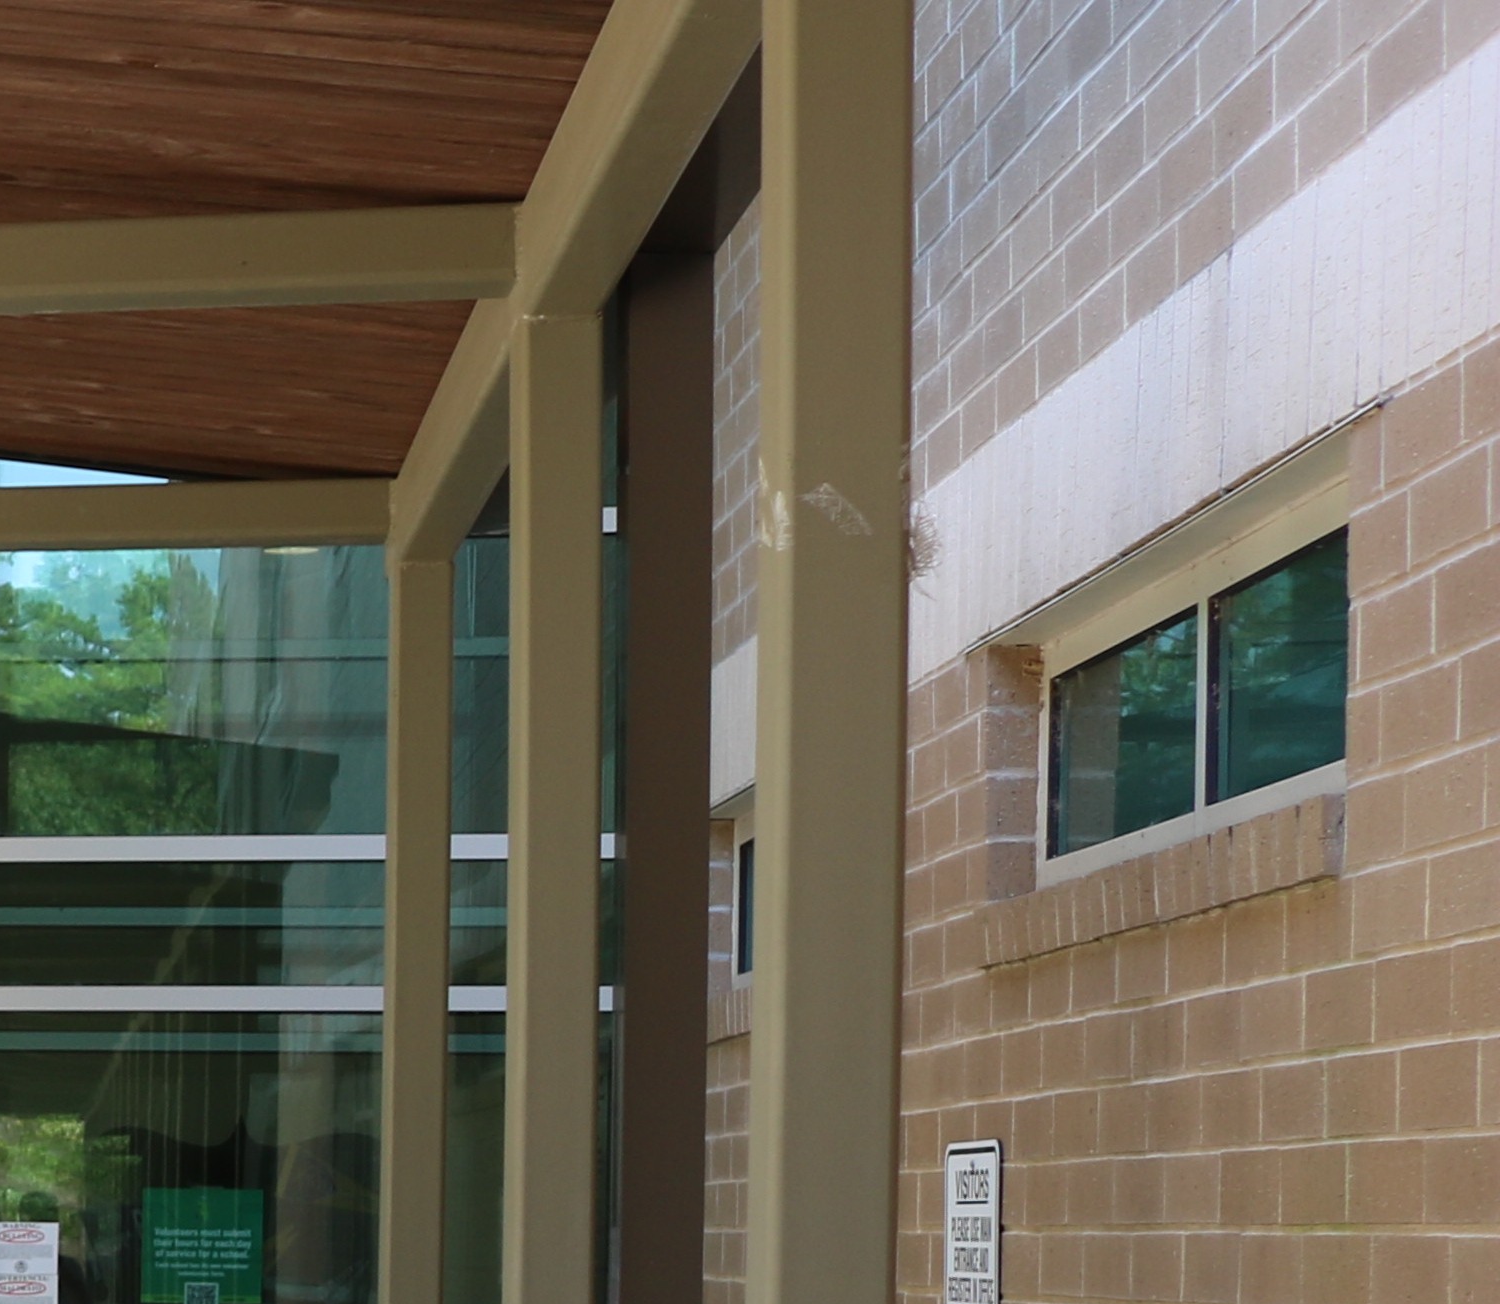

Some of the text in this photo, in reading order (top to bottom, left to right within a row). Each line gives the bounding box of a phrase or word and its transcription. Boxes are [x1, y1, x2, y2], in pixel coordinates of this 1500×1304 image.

[955, 1170, 989, 1199] VISITORS
[154, 1227, 252, 1238] Volunteers must submit
[951, 1216, 992, 1242] PLEASE USE MAIN
[153, 1238, 252, 1250] their hours for each day
[155, 1249, 164, 1257] of
[165, 1250, 197, 1258] service
[198, 1249, 211, 1258] for
[954, 1247, 988, 1273] ENTRANCE AND
[949, 1276, 993, 1304] REGISTER IN OFFICE
